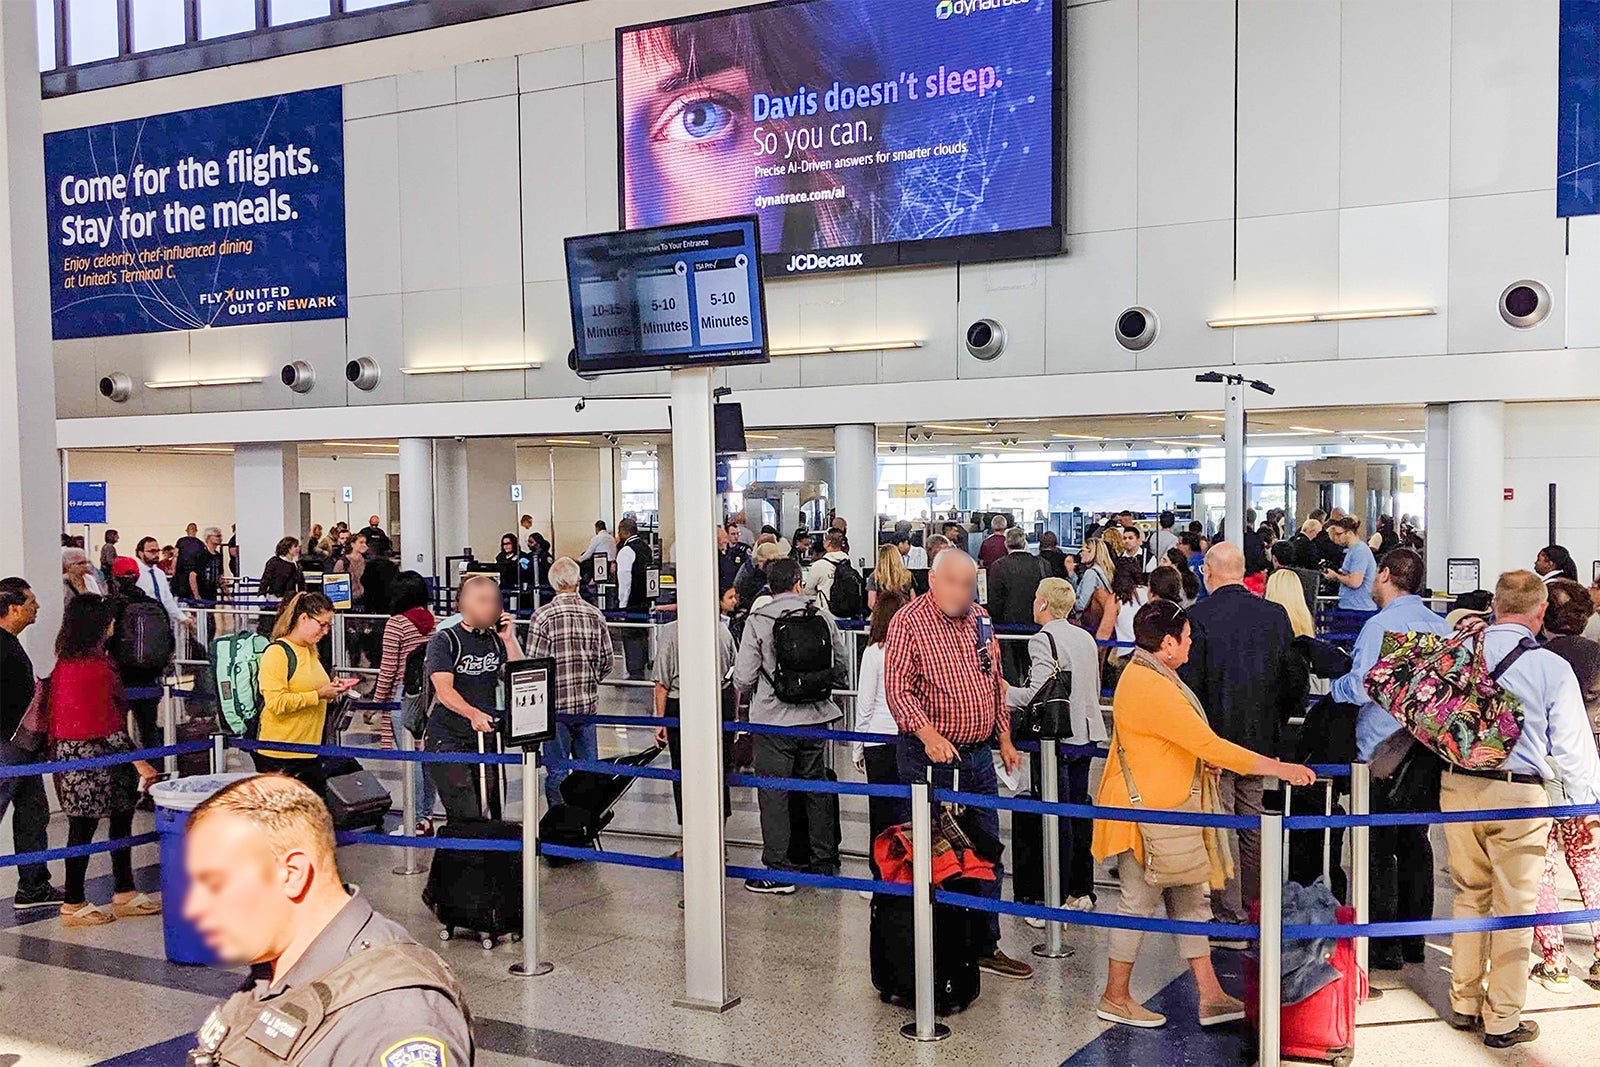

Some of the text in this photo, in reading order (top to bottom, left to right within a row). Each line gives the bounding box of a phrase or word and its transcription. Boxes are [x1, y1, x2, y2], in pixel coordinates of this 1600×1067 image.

[953, 0, 1030, 16] dynatr
[753, 65, 1003, 122] Davis doesn't sleep.
[753, 120, 873, 159] So you can.
[754, 141, 969, 178] Precise AI-Driven answers for smarter clouds.
[60, 143, 319, 206] Come for the flights.
[61, 188, 299, 248] Stay for the meals.
[682, 238, 709, 249] Entrance
[63, 238, 253, 273] Enjoy celebrity chef-influenced dining
[786, 252, 864, 272] JCDecaux
[63, 264, 176, 289] at United's Terminal C.
[200, 286, 290, 304] FLY UNITED
[710, 291, 736, 306] 5-10
[228, 295, 337, 315] OUT OF NEWARK
[651, 297, 676, 312] 5-10
[643, 320, 689, 335] Minutes
[701, 315, 749, 329] Minutes
[586, 325, 631, 339] Minutes
[513, 487, 520, 498] 3
[926, 480, 936, 493] 2
[1153, 477, 1159, 491] 1
[344, 489, 351, 499] 4
[393, 1049, 438, 1067] POLICE
